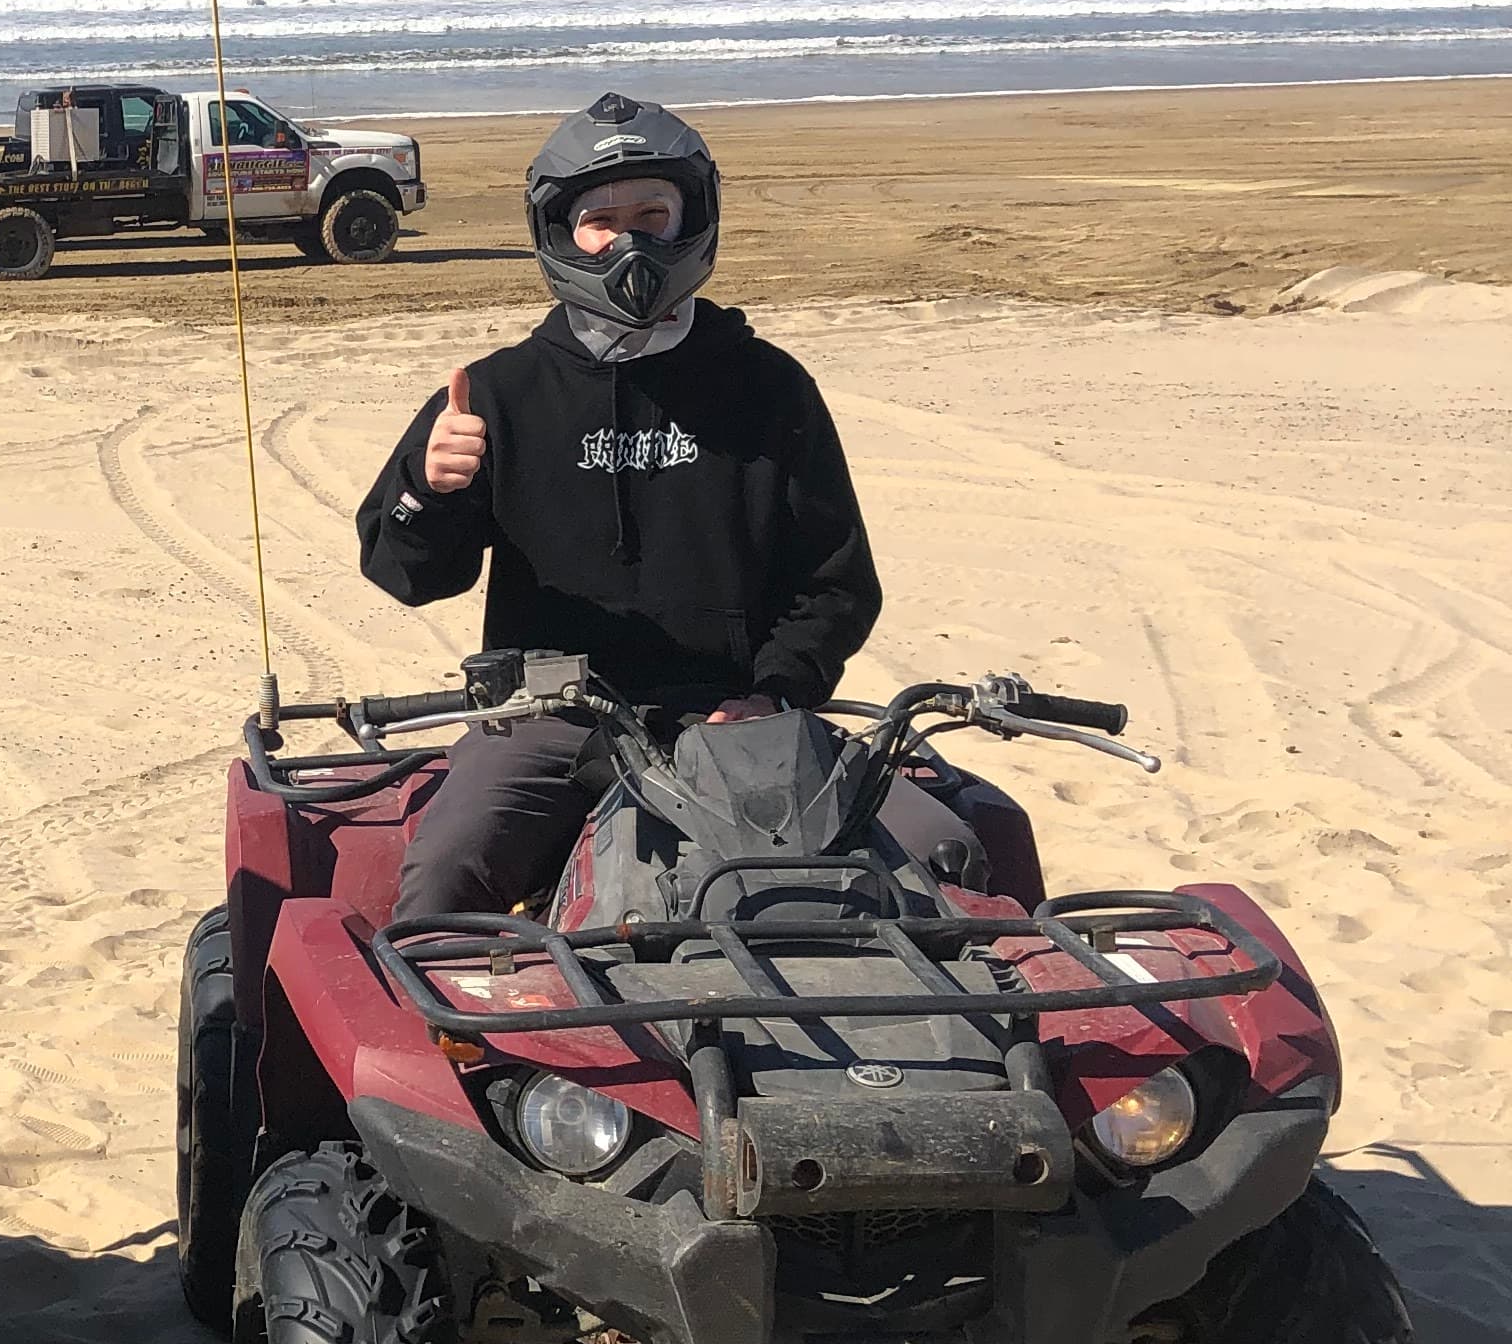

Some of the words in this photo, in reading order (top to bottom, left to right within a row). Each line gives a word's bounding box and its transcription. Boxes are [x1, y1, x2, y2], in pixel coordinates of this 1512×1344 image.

[8, 184, 25, 194] THE
[28, 183, 50, 193] BEST
[83, 181, 96, 191] ON
